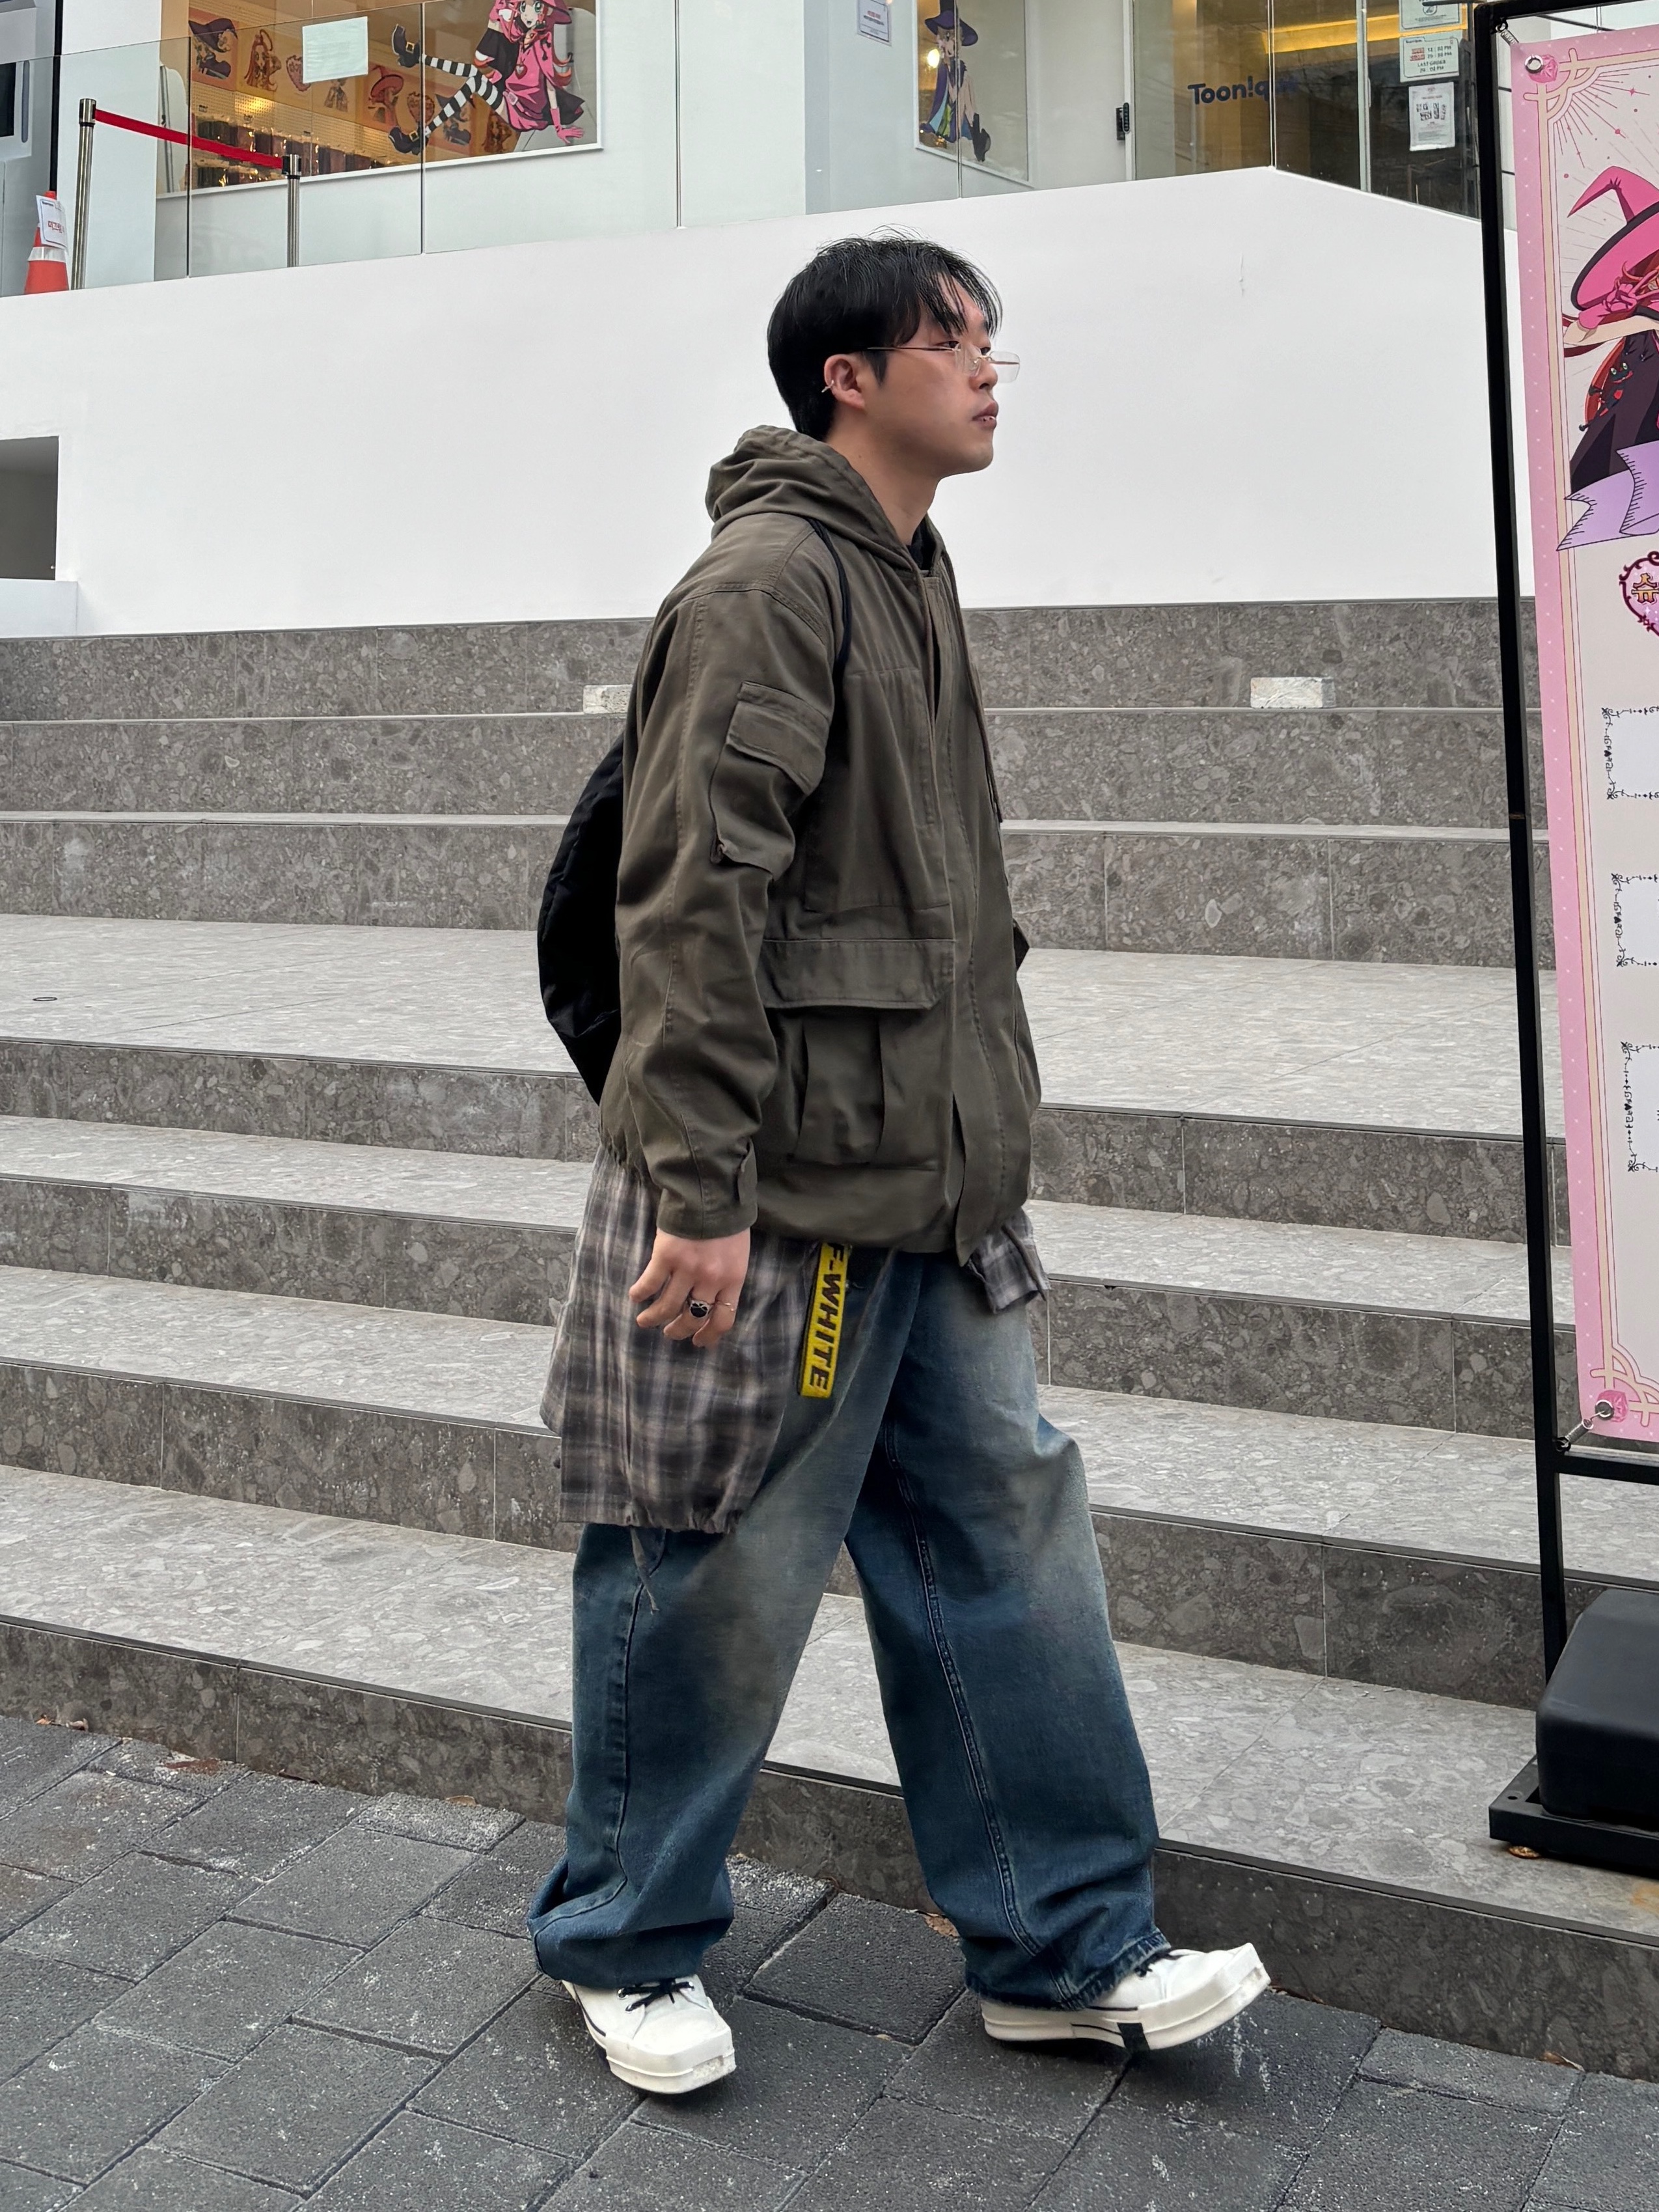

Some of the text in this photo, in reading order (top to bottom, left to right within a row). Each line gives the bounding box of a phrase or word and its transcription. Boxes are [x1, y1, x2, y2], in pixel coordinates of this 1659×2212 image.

[1187, 75, 1298, 105] Toon!q
[1631, 573, 1659, 603] 슈
[810, 1242, 845, 1390] F-WHITE
